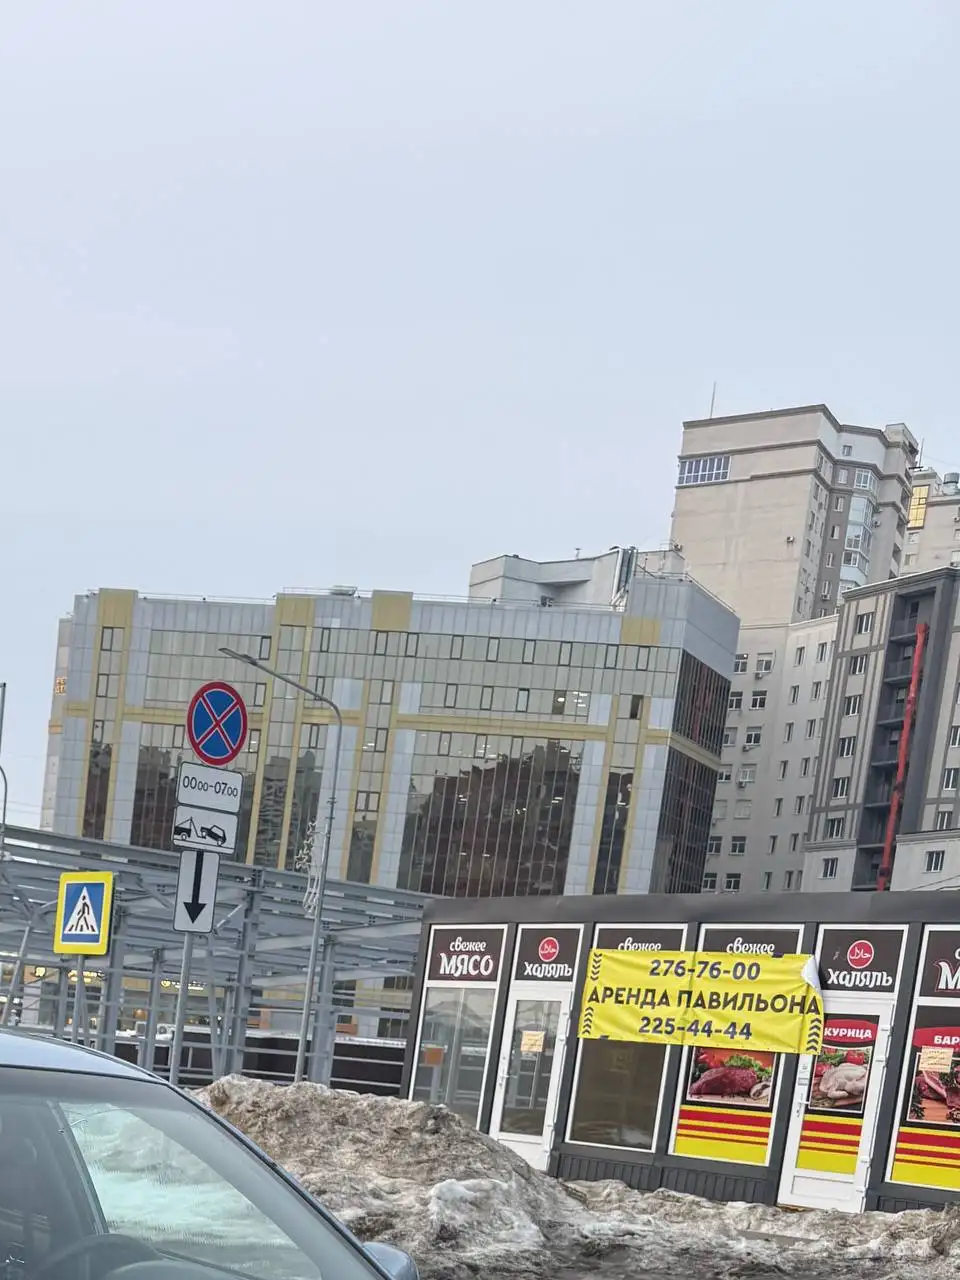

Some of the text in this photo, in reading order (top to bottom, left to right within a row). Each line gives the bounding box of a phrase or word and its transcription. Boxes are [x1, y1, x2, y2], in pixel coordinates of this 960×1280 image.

[449, 936, 487, 952] свежее
[439, 952, 494, 977] МЯСО
[649, 958, 761, 981] 276-76-00
[588, 986, 821, 1016] АРЕНДА ПАВИЛЬОНА
[639, 1016, 752, 1040] 225-44-44
[824, 1026, 873, 1040] КУРИЦА
